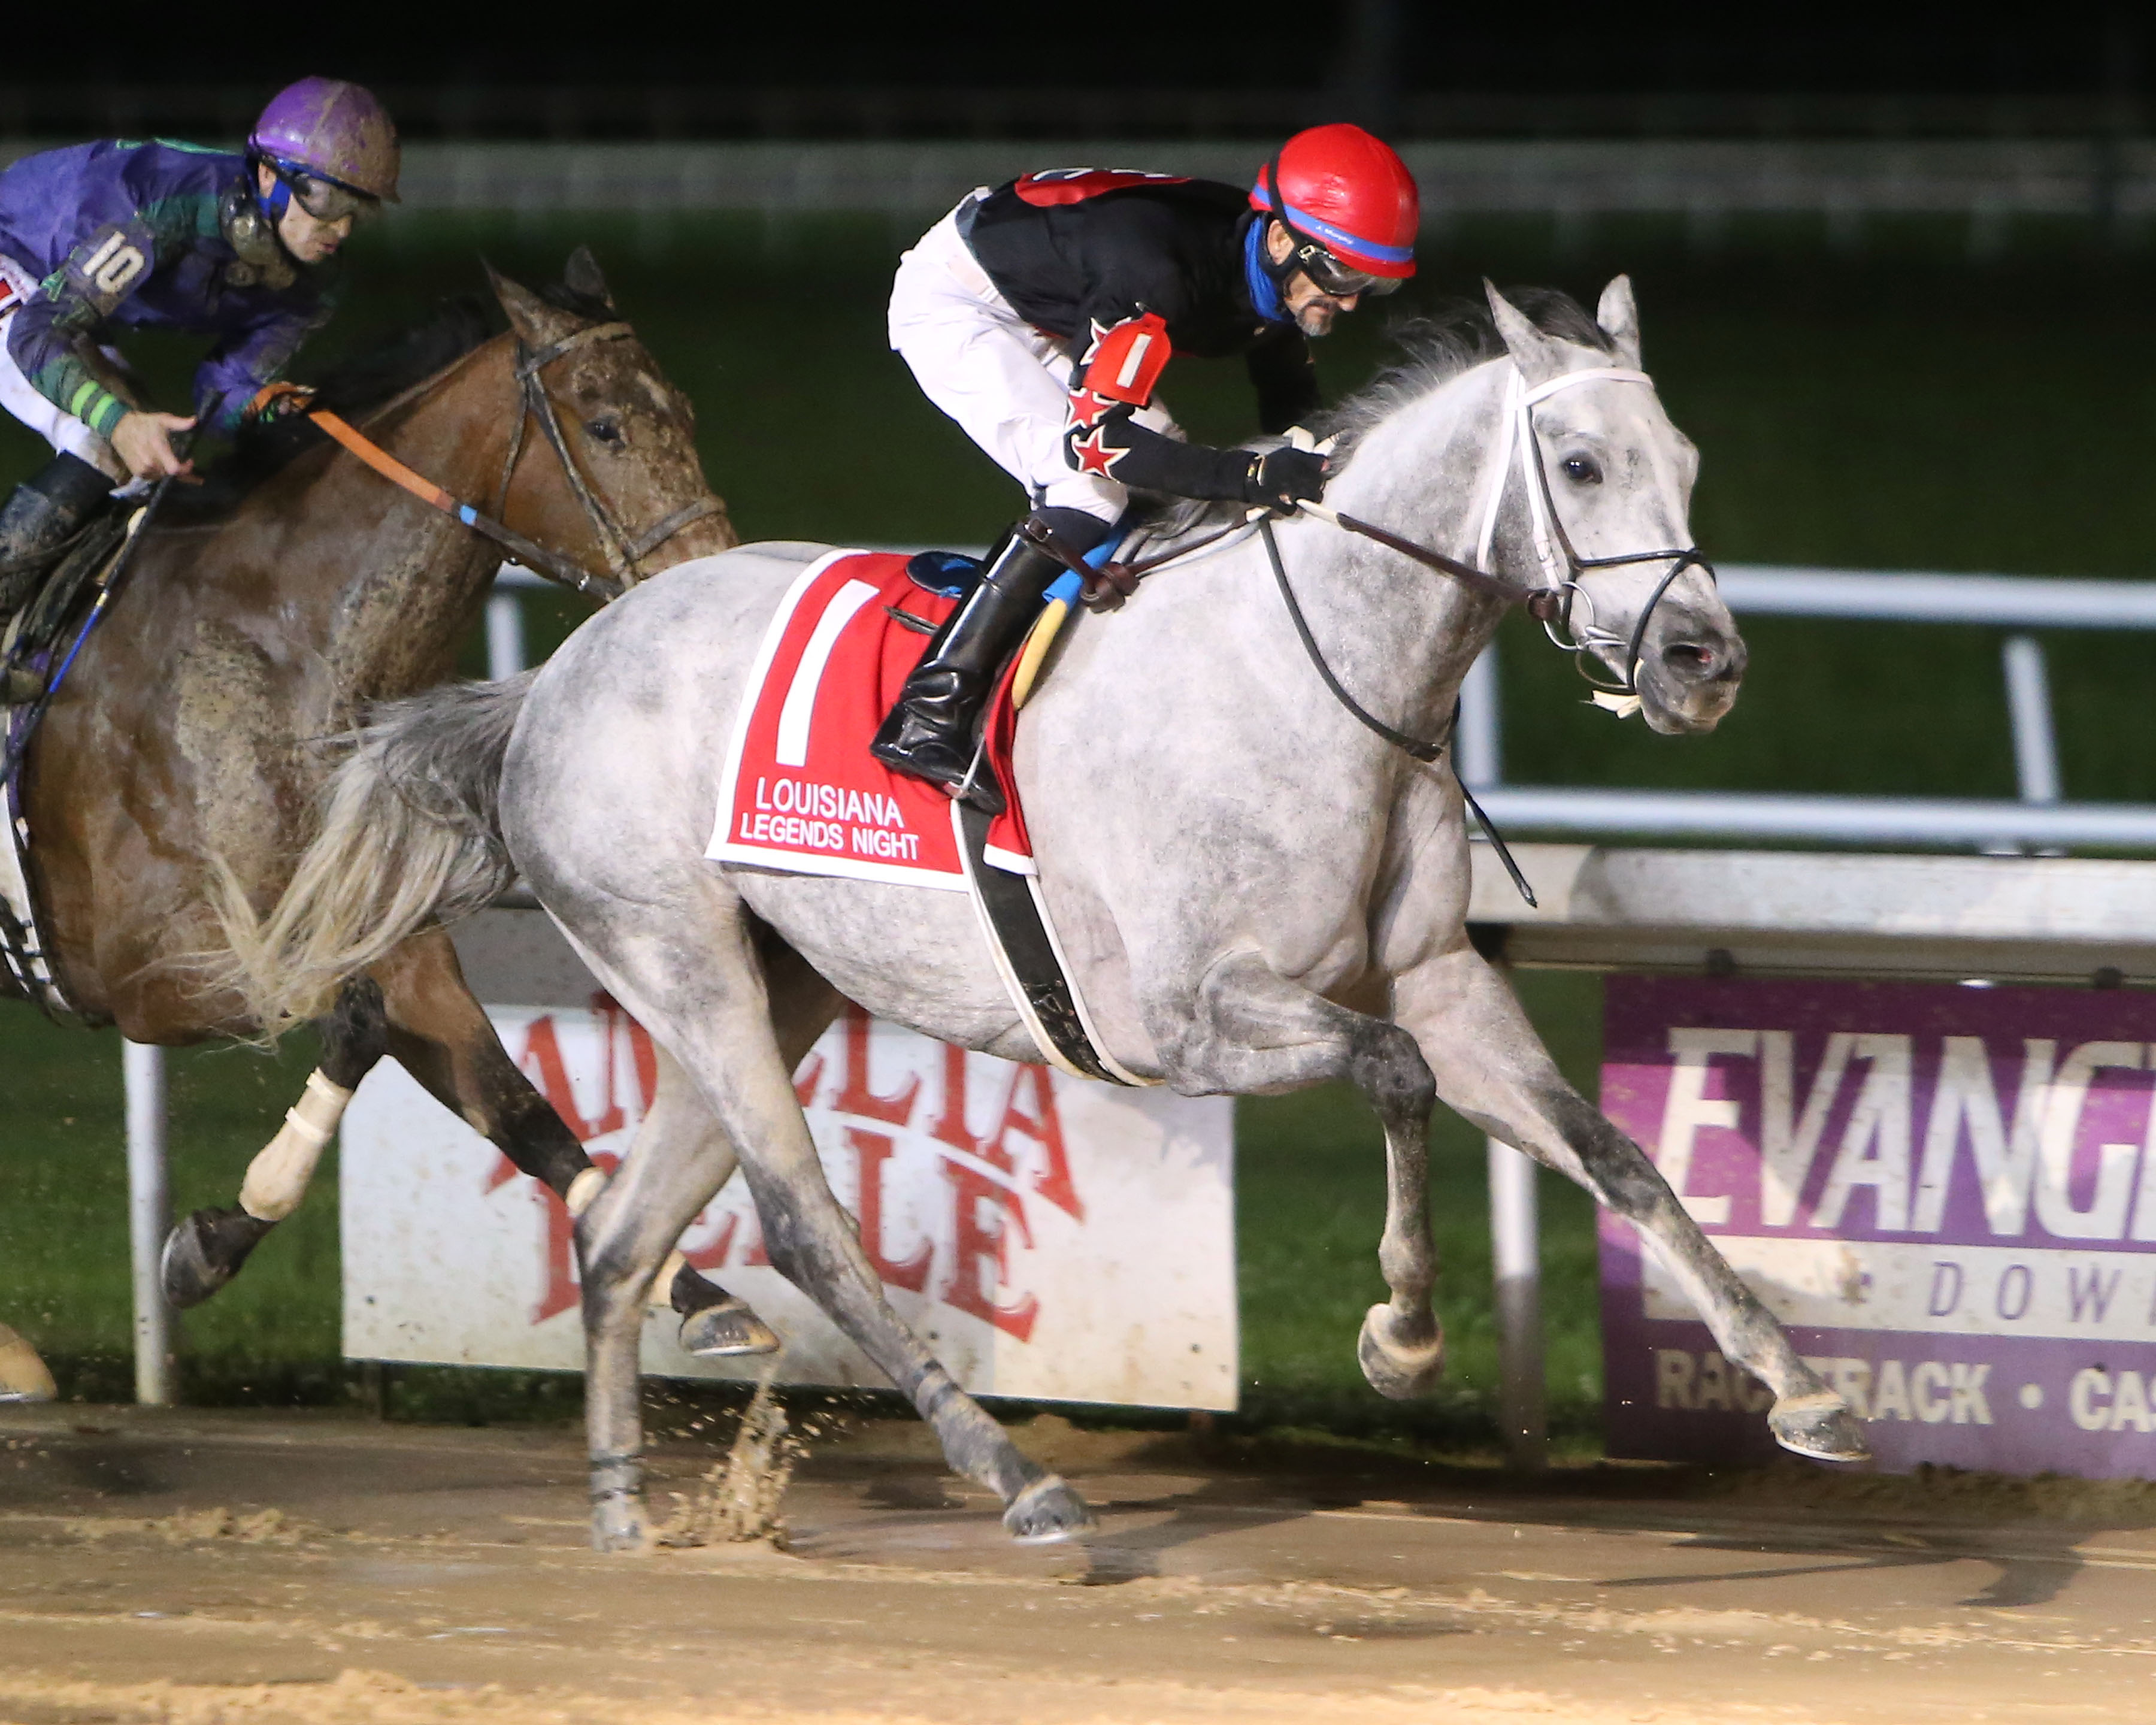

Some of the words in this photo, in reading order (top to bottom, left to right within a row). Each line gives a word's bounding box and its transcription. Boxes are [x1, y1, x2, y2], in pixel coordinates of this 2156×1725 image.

[83, 231, 144, 292] 10
[1117, 333, 1152, 388] 1
[776, 578, 880, 767] 1
[755, 776, 905, 829] LOUISIANA
[739, 812, 844, 850] LEGENDS
[852, 827, 919, 861] NIGHT
[1929, 1261, 2156, 1326] DOW
[2070, 1367, 2156, 1433] CA
